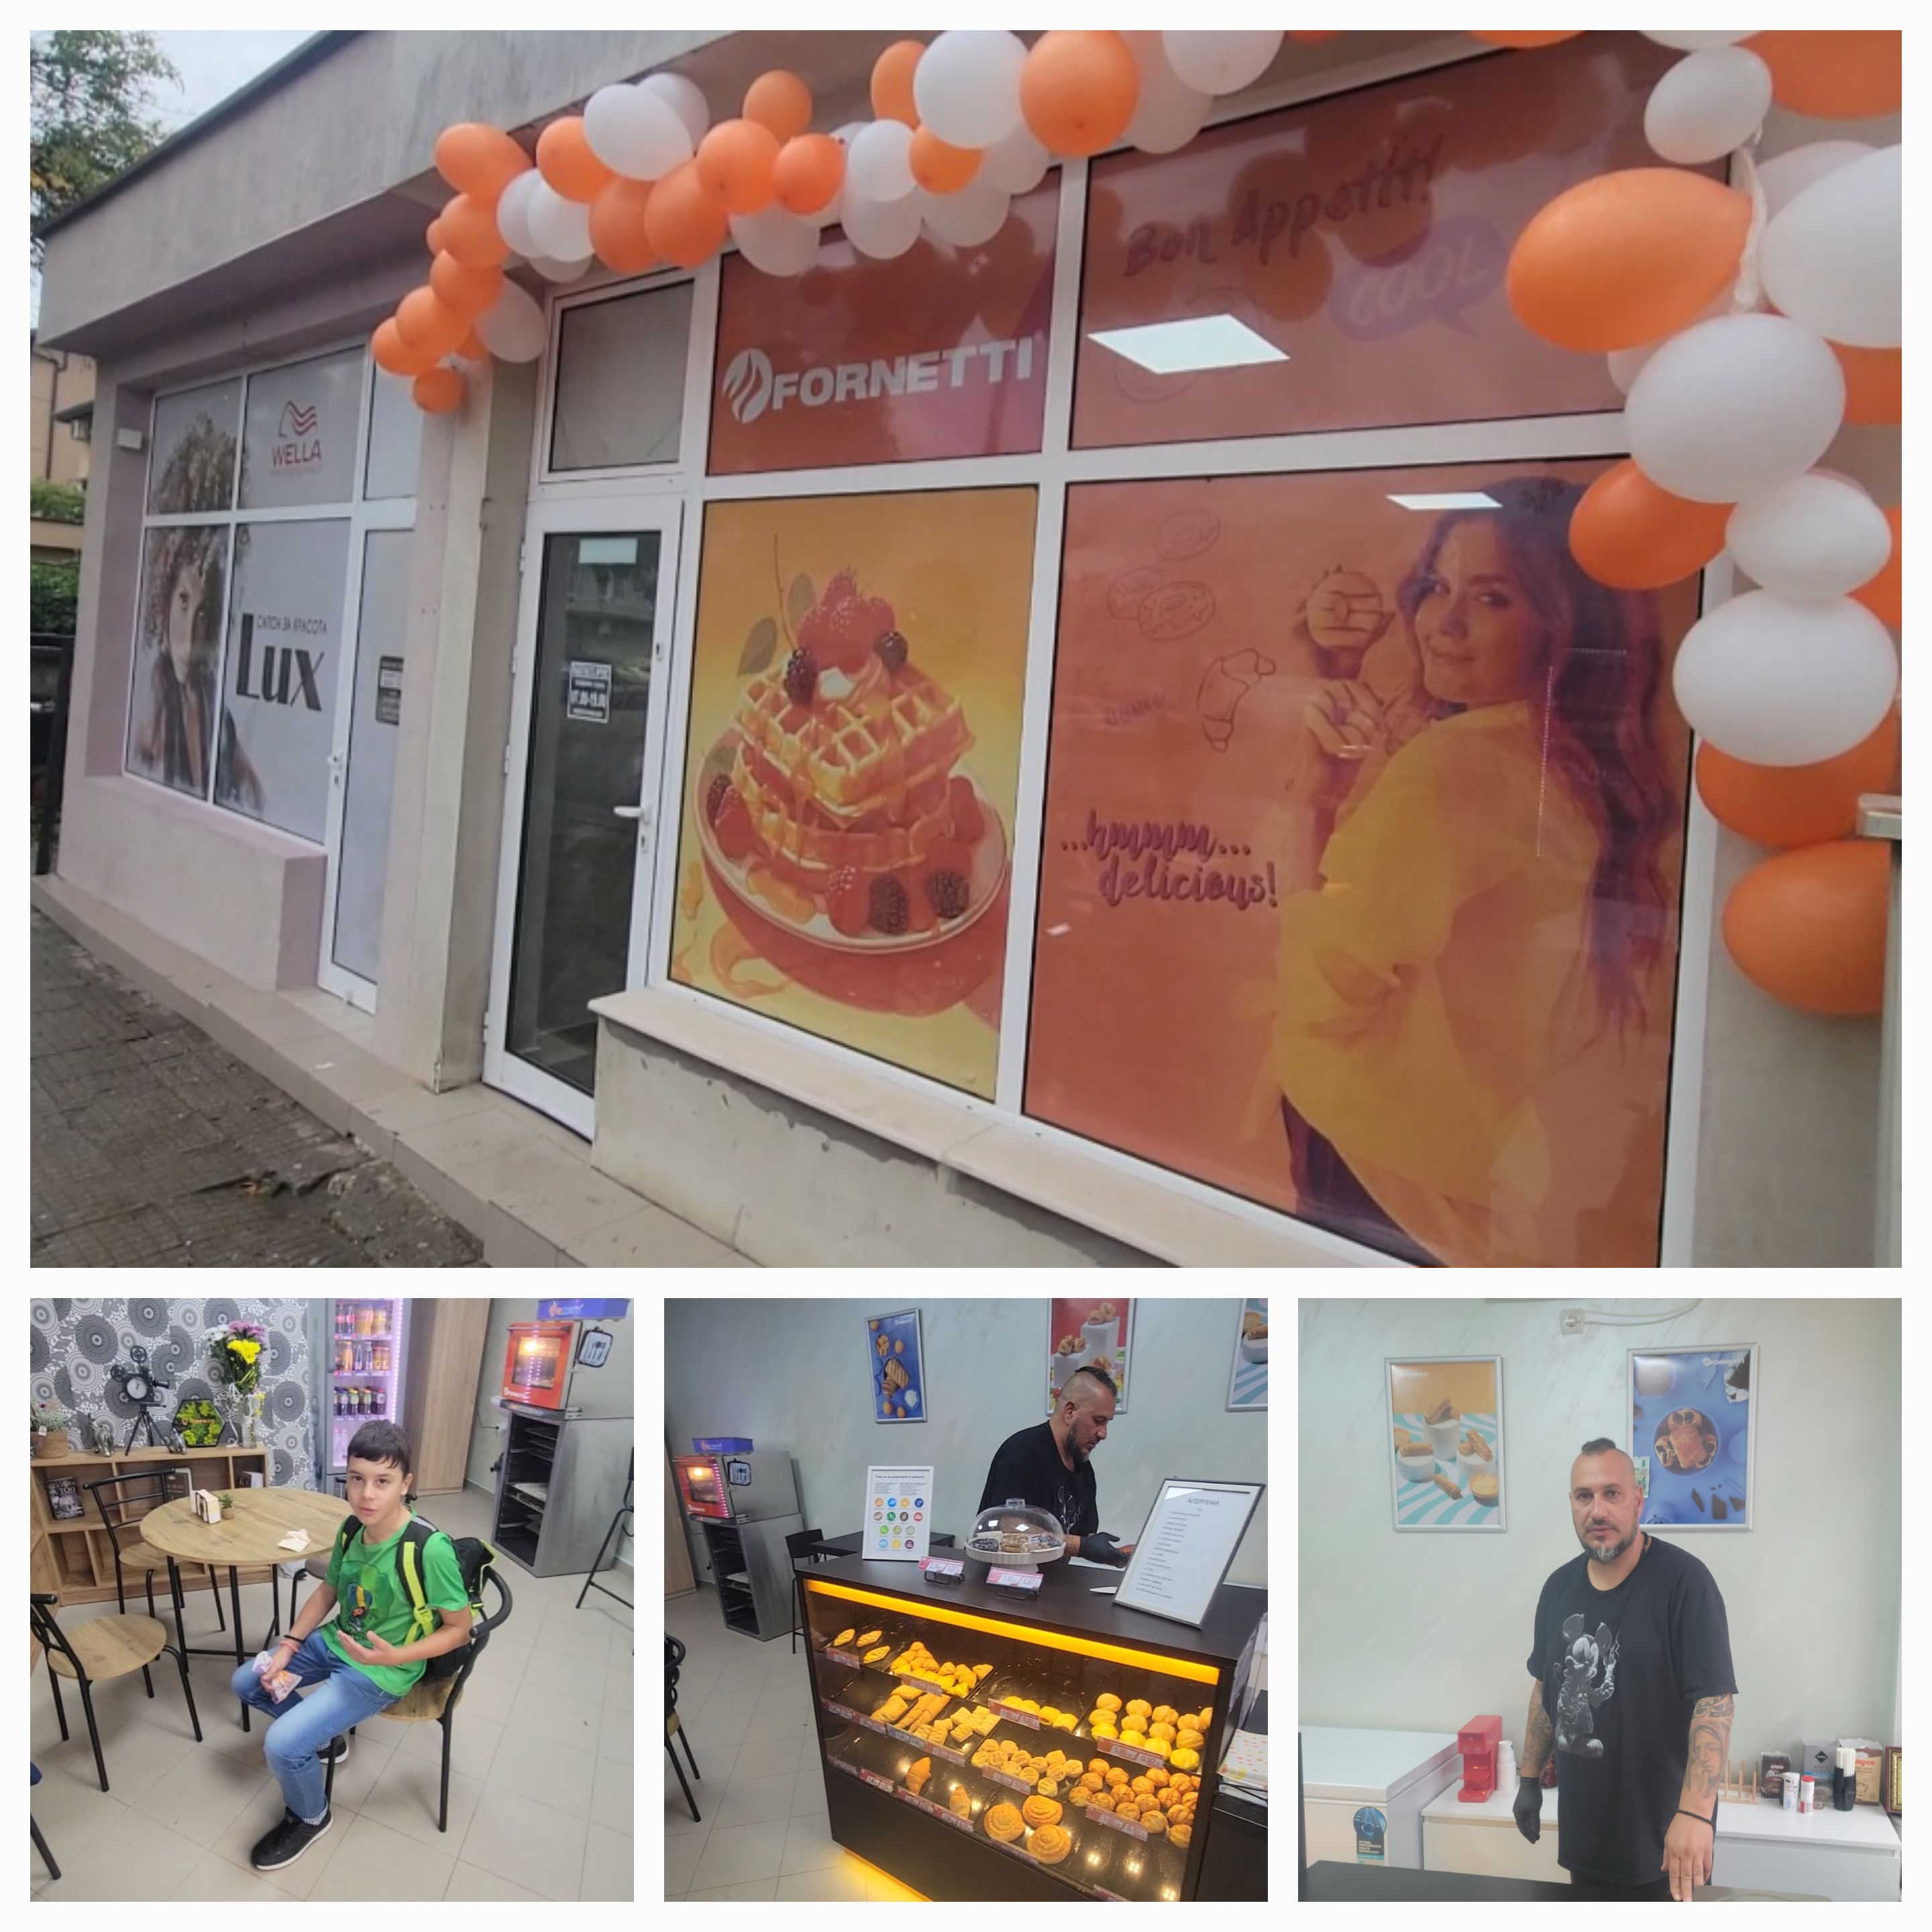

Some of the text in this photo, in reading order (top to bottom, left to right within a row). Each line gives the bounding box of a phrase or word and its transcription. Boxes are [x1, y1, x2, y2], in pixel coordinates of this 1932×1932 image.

[1124, 221, 1218, 276] Bon
[1348, 235, 1488, 325] COOL
[772, 337, 1034, 411] FORNETTI
[272, 440, 322, 467] WELLA
[236, 612, 325, 711] Lux
[1098, 853, 1278, 910] delicious!
